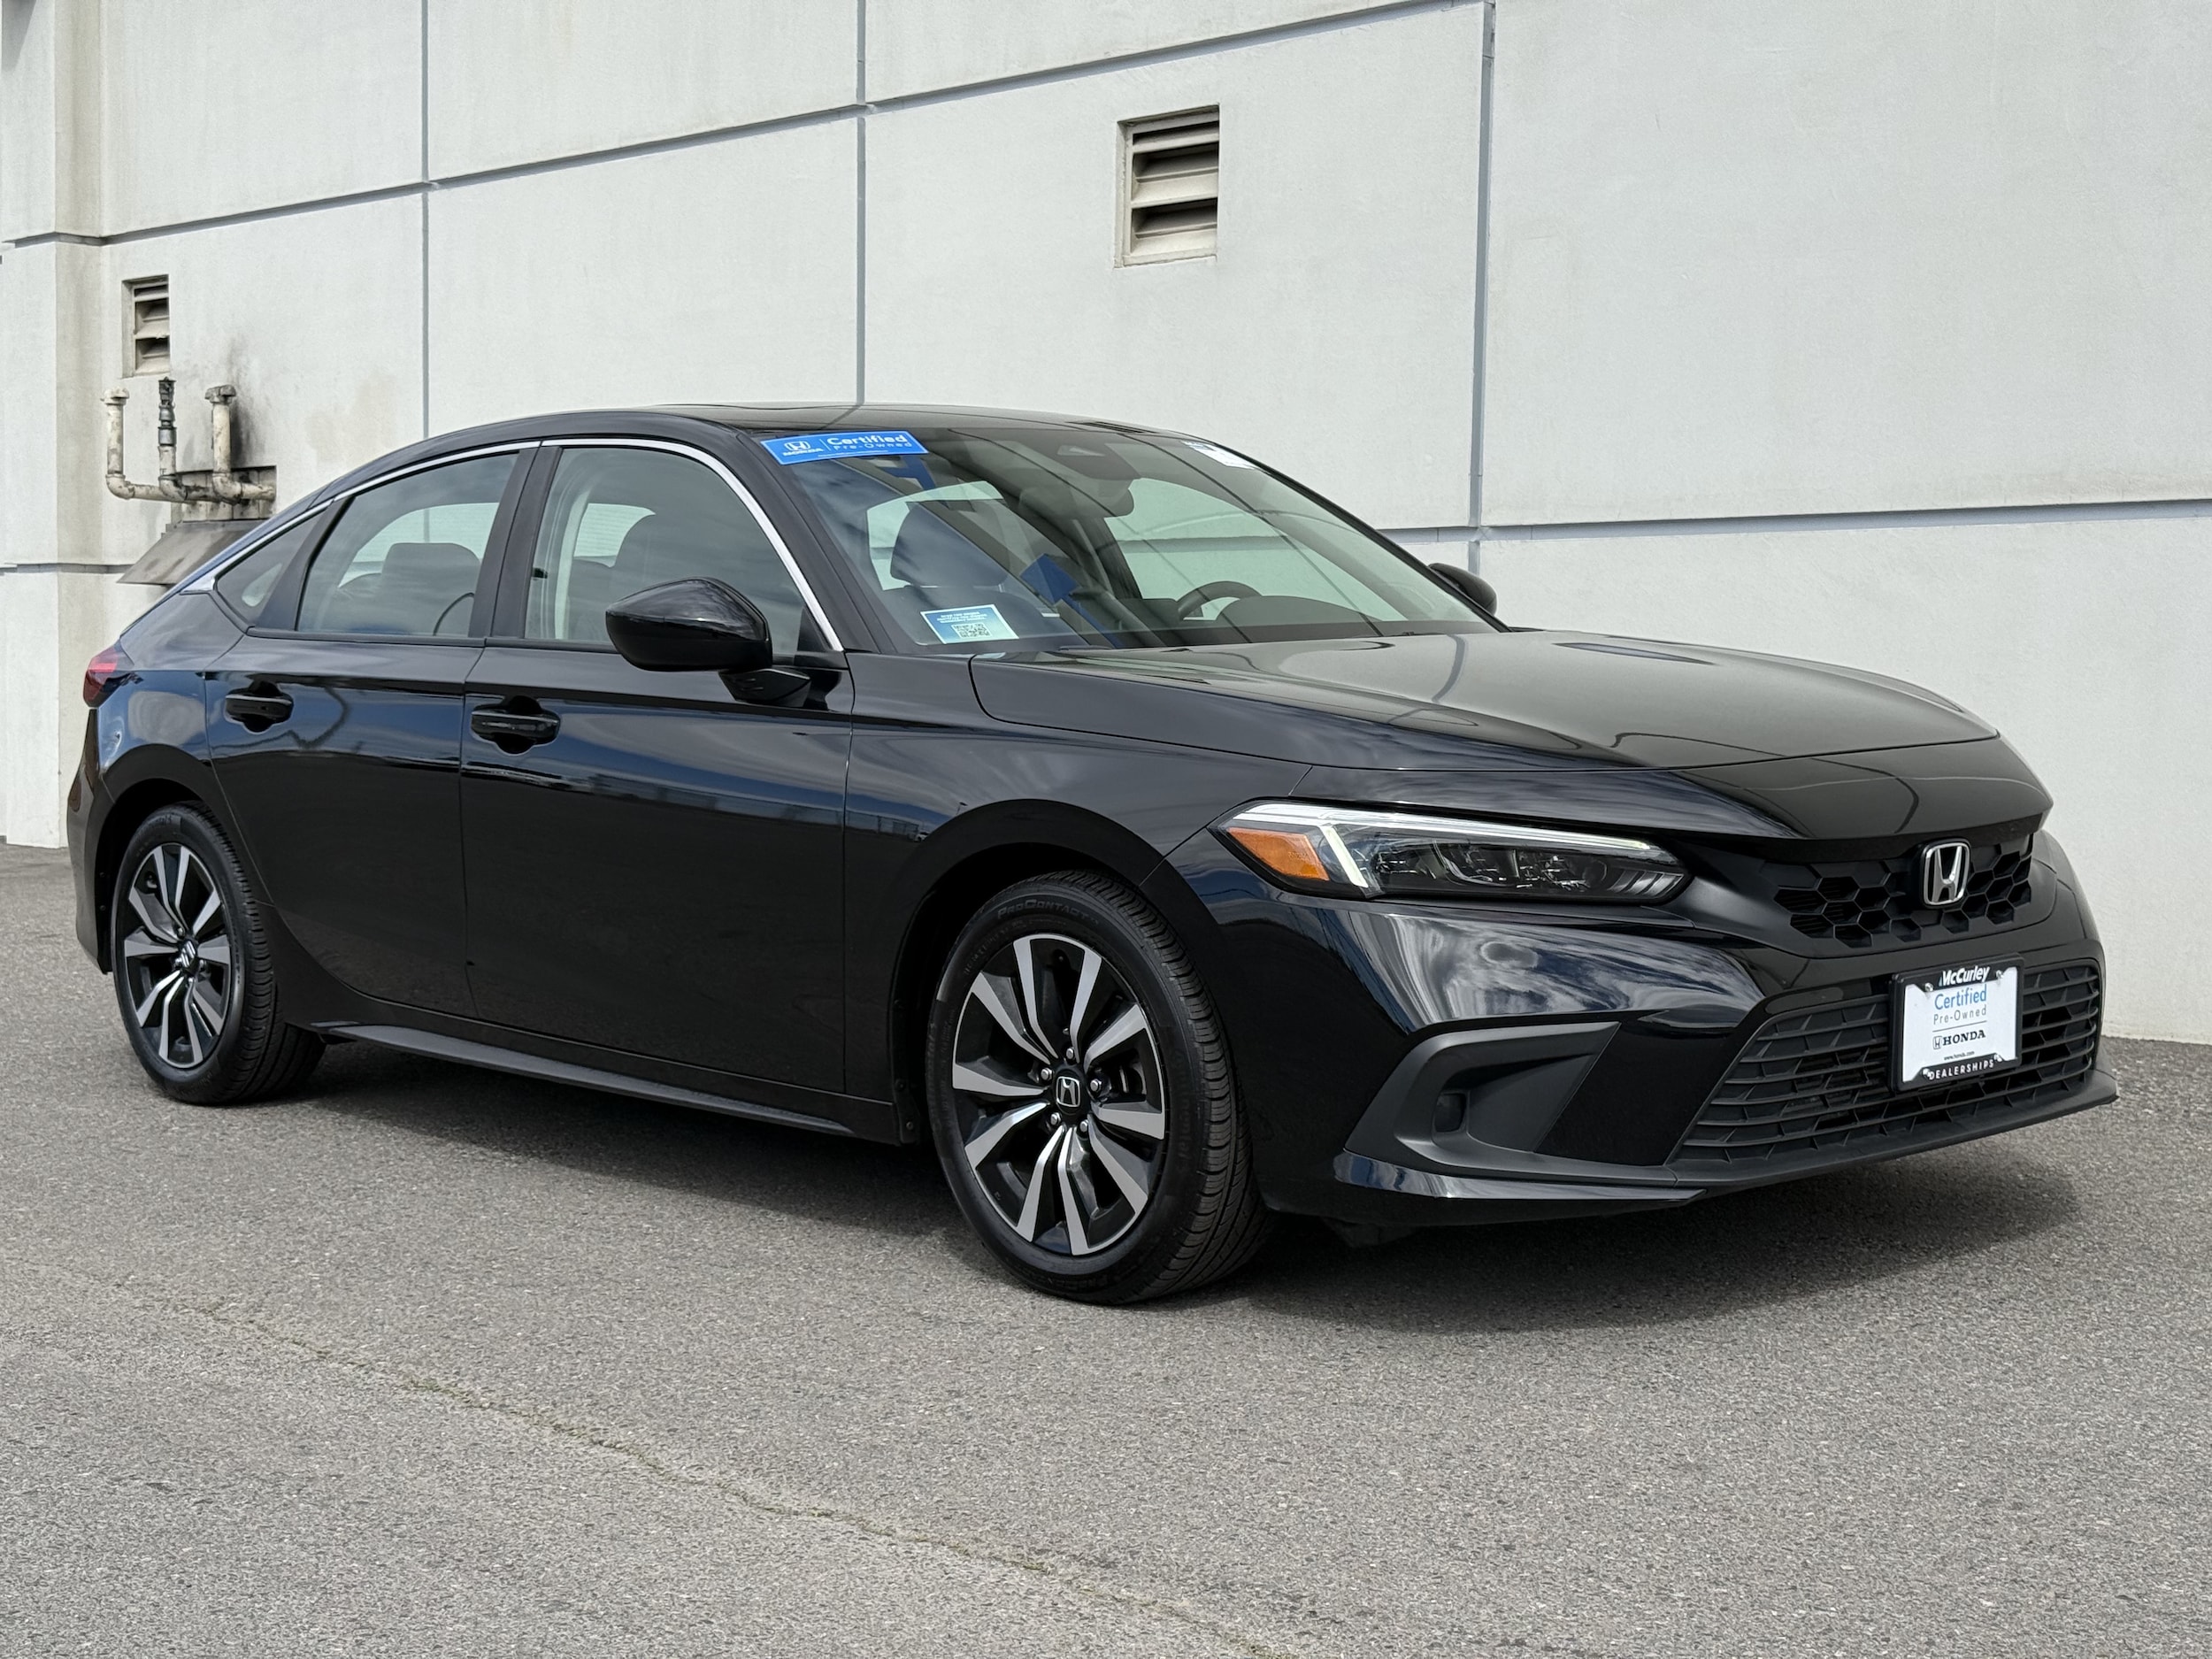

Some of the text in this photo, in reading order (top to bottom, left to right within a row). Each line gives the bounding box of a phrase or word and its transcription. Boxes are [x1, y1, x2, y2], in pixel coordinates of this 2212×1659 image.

[826, 434, 908, 445] Certified
[833, 442, 913, 450] Pre-Owned
[1940, 965, 1990, 987] McCurley
[1934, 984, 1987, 1010] Certified
[1933, 1005, 1986, 1025] Pre-Owned
[1942, 1030, 1985, 1046] HONDA
[1929, 1059, 1994, 1080] DEALERSHIPS
